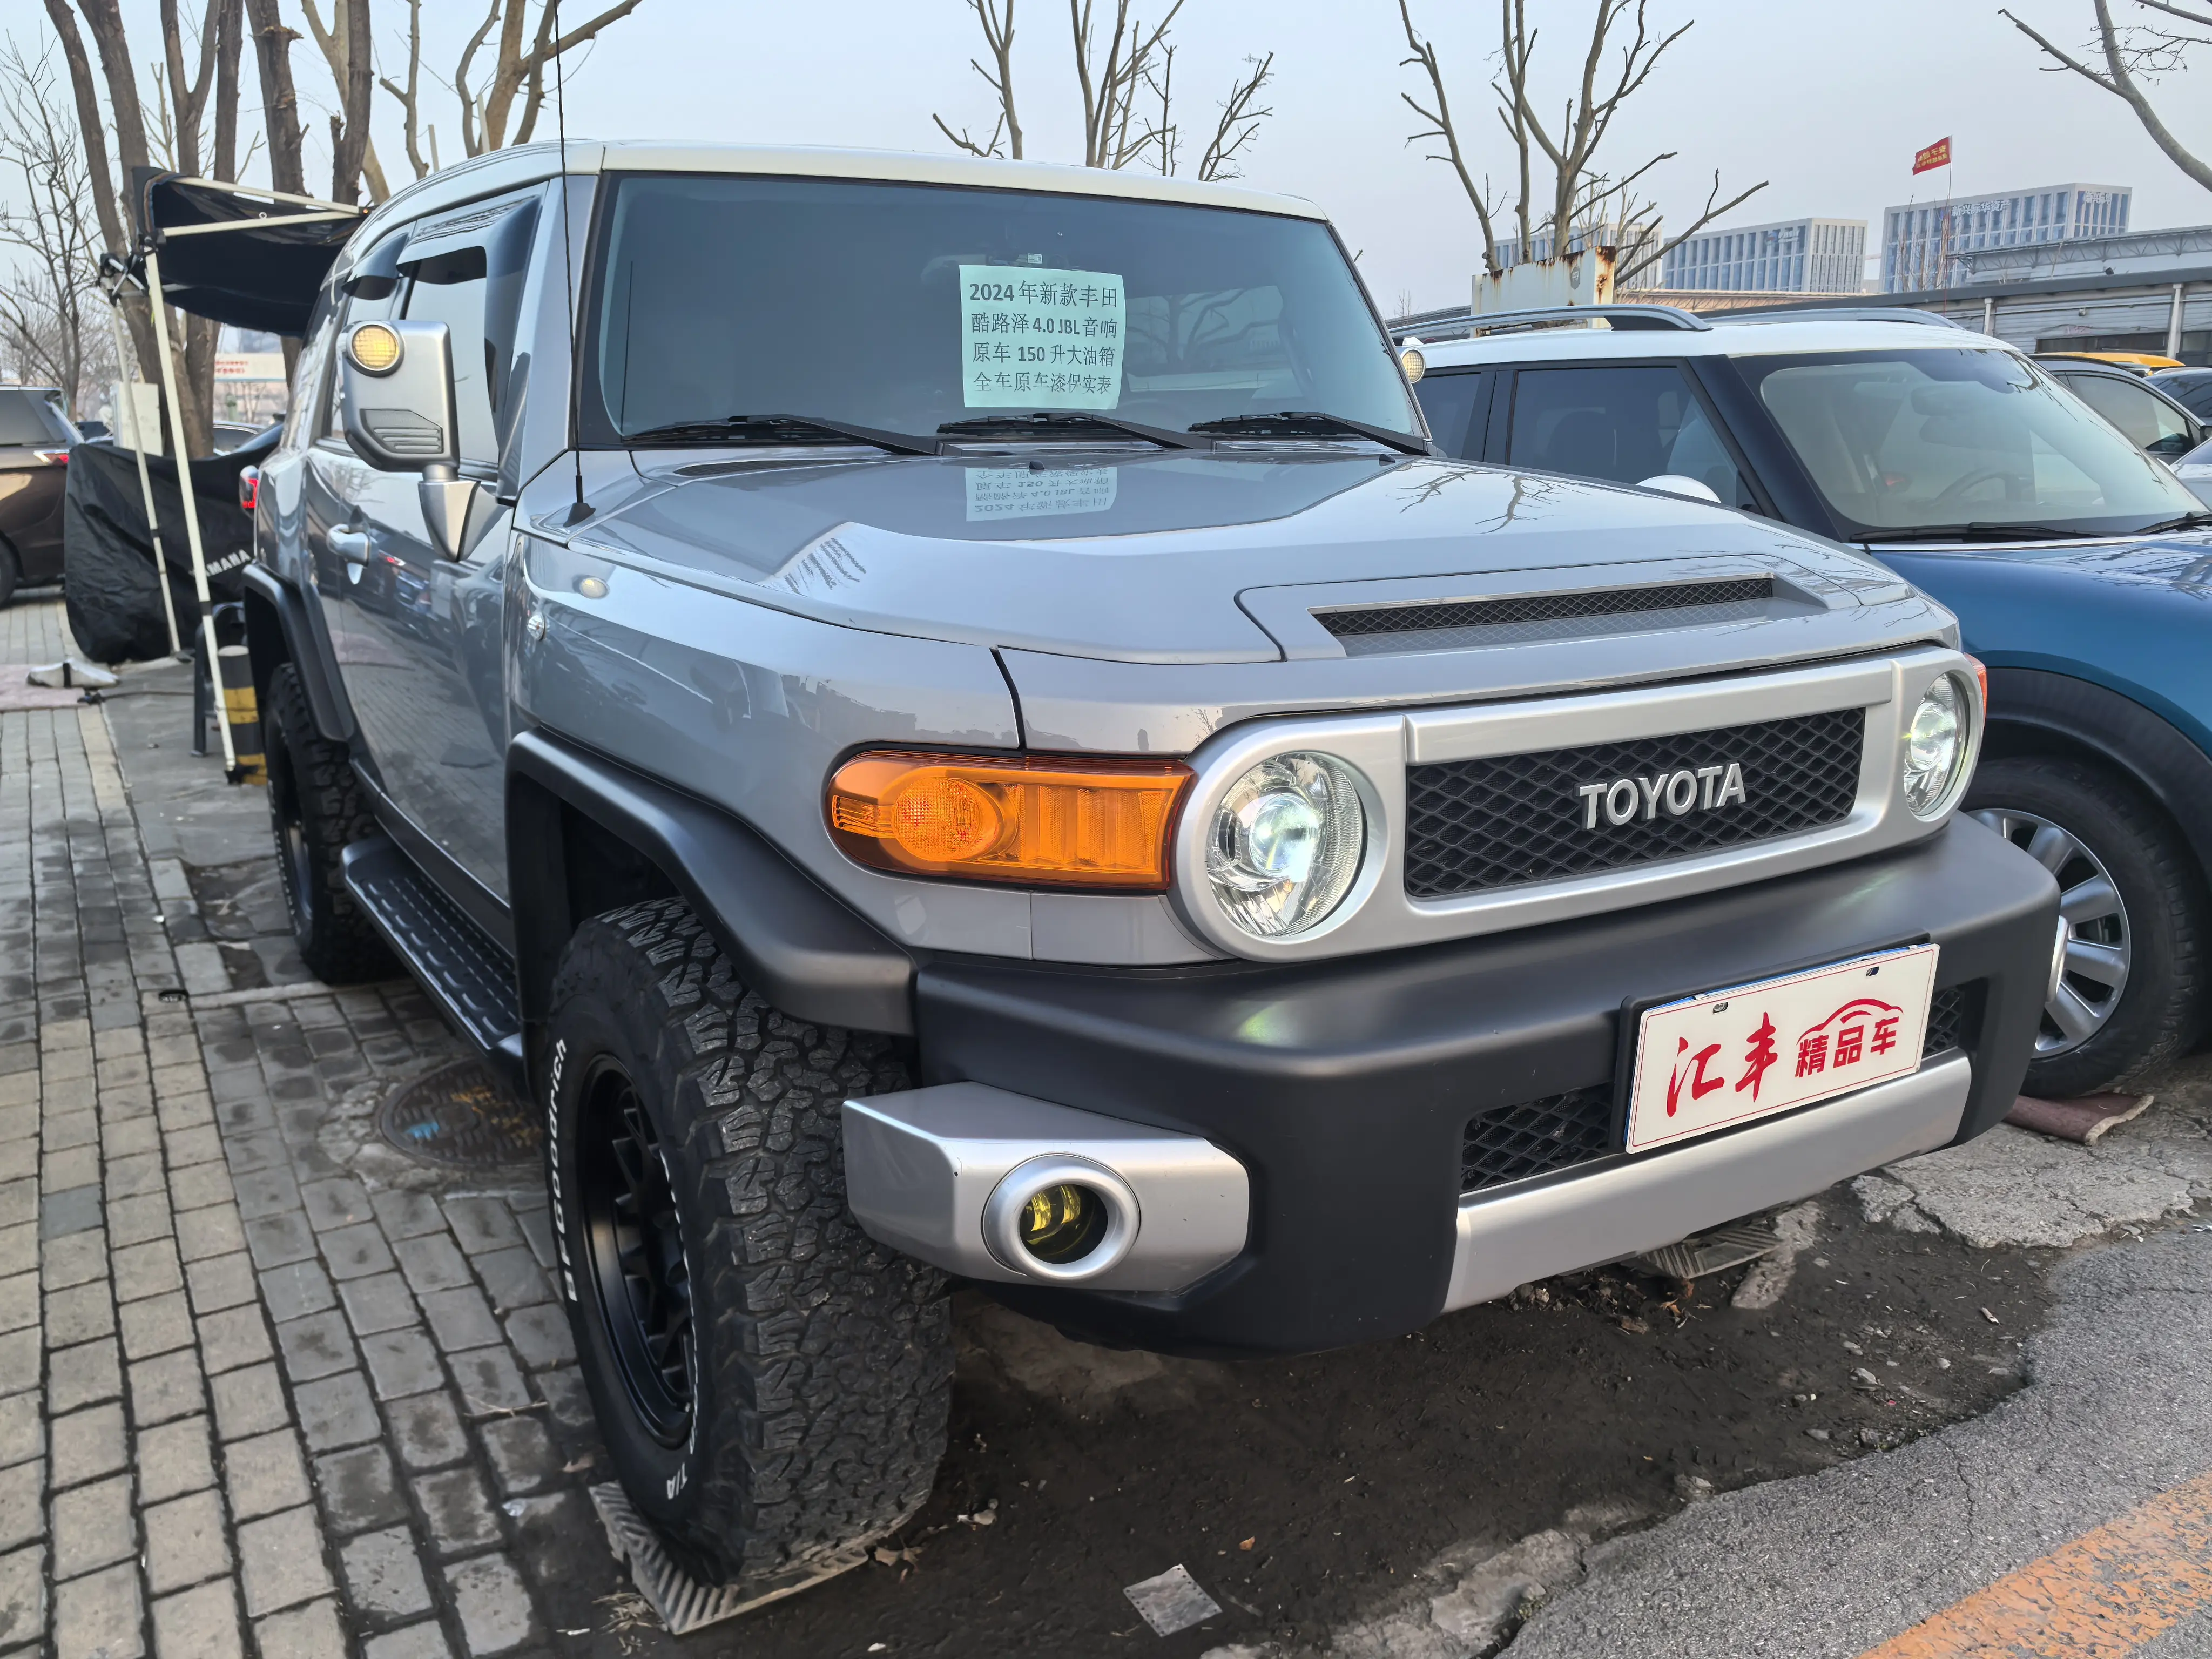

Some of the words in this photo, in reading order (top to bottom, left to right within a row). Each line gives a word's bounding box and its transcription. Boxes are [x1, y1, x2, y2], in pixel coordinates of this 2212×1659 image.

[972, 312, 1029, 334] 酷路泽
[1033, 317, 1055, 333] 4.0
[1058, 319, 1080, 335] JBL
[1082, 316, 1117, 338] 音响
[973, 342, 1011, 363] 原车
[1017, 346, 1045, 362] 150
[1050, 344, 1116, 367] 升大油箱
[973, 371, 1112, 395] 全车原车漆保实表
[188, 549, 251, 577] MAHA
[1578, 763, 1746, 830] TOYOTA
[1795, 1016, 1900, 1078] 精品车
